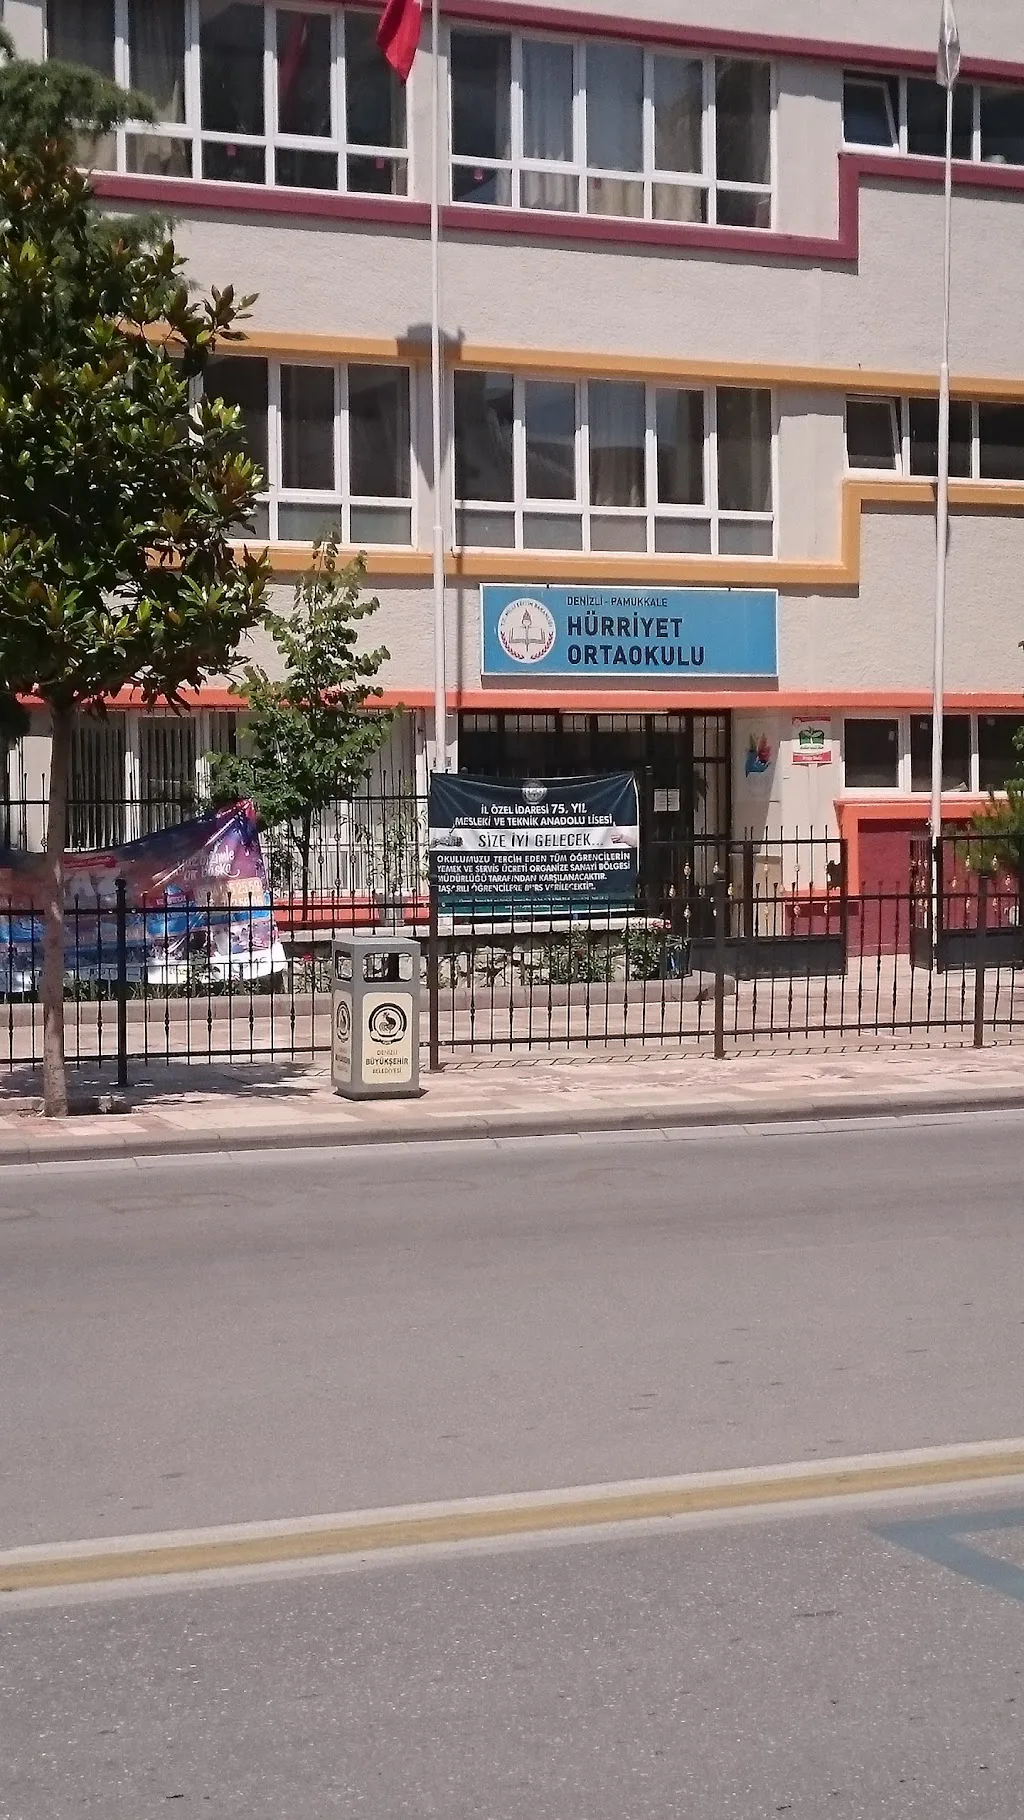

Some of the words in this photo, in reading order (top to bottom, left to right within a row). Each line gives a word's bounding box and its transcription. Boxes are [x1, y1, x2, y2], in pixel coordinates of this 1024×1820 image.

[567, 595, 603, 606] DENİZLİ
[611, 597, 668, 607] PAMUKKALE
[567, 610, 683, 638] HÜRRİYET
[567, 644, 705, 666] ORTAOKULU
[481, 803, 489, 815] İL
[491, 803, 514, 815] ÖZEL
[515, 803, 549, 815] İDARESİ
[454, 815, 491, 826] MESLEKİ
[494, 816, 505, 826] VE
[507, 815, 539, 826] TEKNİK
[540, 816, 586, 826] ANADOLU
[588, 813, 613, 825] LİSESİ
[478, 832, 506, 847] SİZE
[511, 832, 529, 847] İYİ
[436, 855, 491, 863] OKULUMUZU
[493, 854, 522, 863] TERCİH
[525, 855, 547, 863] EDEN
[550, 853, 568, 862] TÜM
[569, 851, 630, 862] ÖĞRENCİLERİN
[437, 865, 461, 873] YEMEK
[463, 865, 473, 873] VE
[475, 863, 499, 873] SERVİS
[501, 863, 528, 873] ÜCRETİ
[529, 863, 569, 872] ORGANİZE
[570, 861, 597, 871] SANAYİ
[598, 861, 630, 870] BÖLGESİ
[437, 873, 487, 883] MÜDÜRLÜĞÜ
[488, 874, 537, 882] TARAFINDAN
[539, 872, 608, 883] KARŞILANACAKTIR.
[366, 1057, 409, 1066] BÜYÜKŞEHİR
